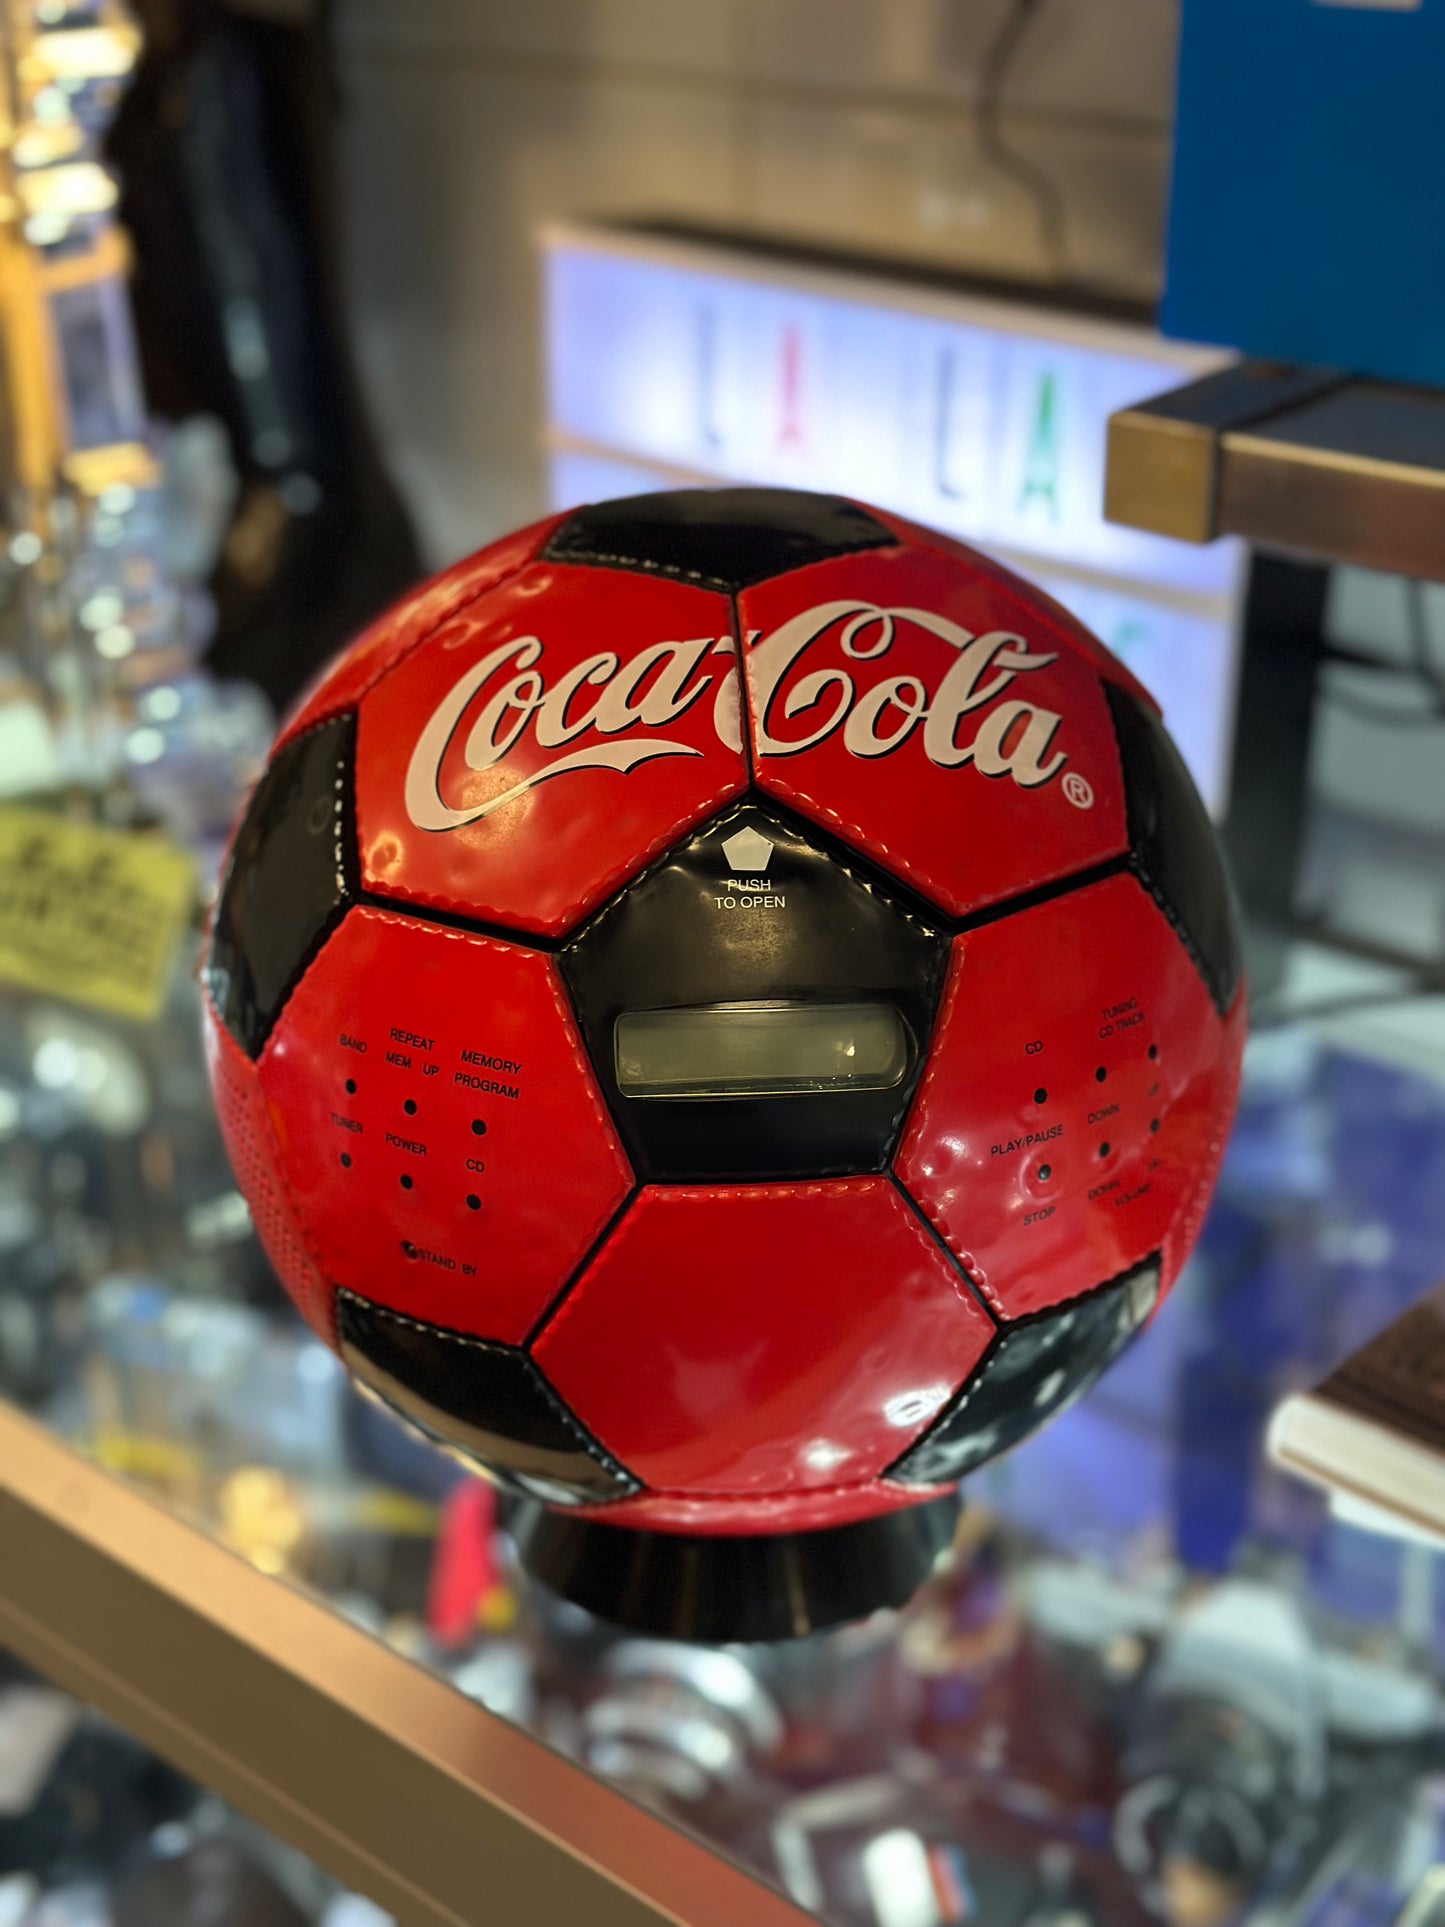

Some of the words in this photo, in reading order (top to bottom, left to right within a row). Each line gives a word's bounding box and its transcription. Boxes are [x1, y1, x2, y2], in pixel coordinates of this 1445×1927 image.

[727, 879, 771, 892] PUSH
[714, 896, 736, 909] TO
[740, 896, 786, 908] OPEN
[339, 1033, 368, 1053] BAND
[390, 1027, 435, 1052] REPEAT
[1098, 1024, 1114, 1039] CD
[1024, 1040, 1044, 1055] CD
[385, 1051, 412, 1069] MEM
[422, 1063, 440, 1077] UP
[460, 1049, 522, 1076] MEMORY
[453, 1072, 520, 1100] PROGRAM
[330, 1112, 364, 1135] TUNER
[1087, 1103, 1120, 1126] DOWN
[385, 1132, 427, 1156] POWER
[990, 1124, 1064, 1157] PLAY/PAUSE
[465, 1158, 485, 1174] CD
[1023, 1206, 1056, 1227] STOP
[417, 1248, 456, 1271] STAND
[461, 1263, 478, 1277] BY
